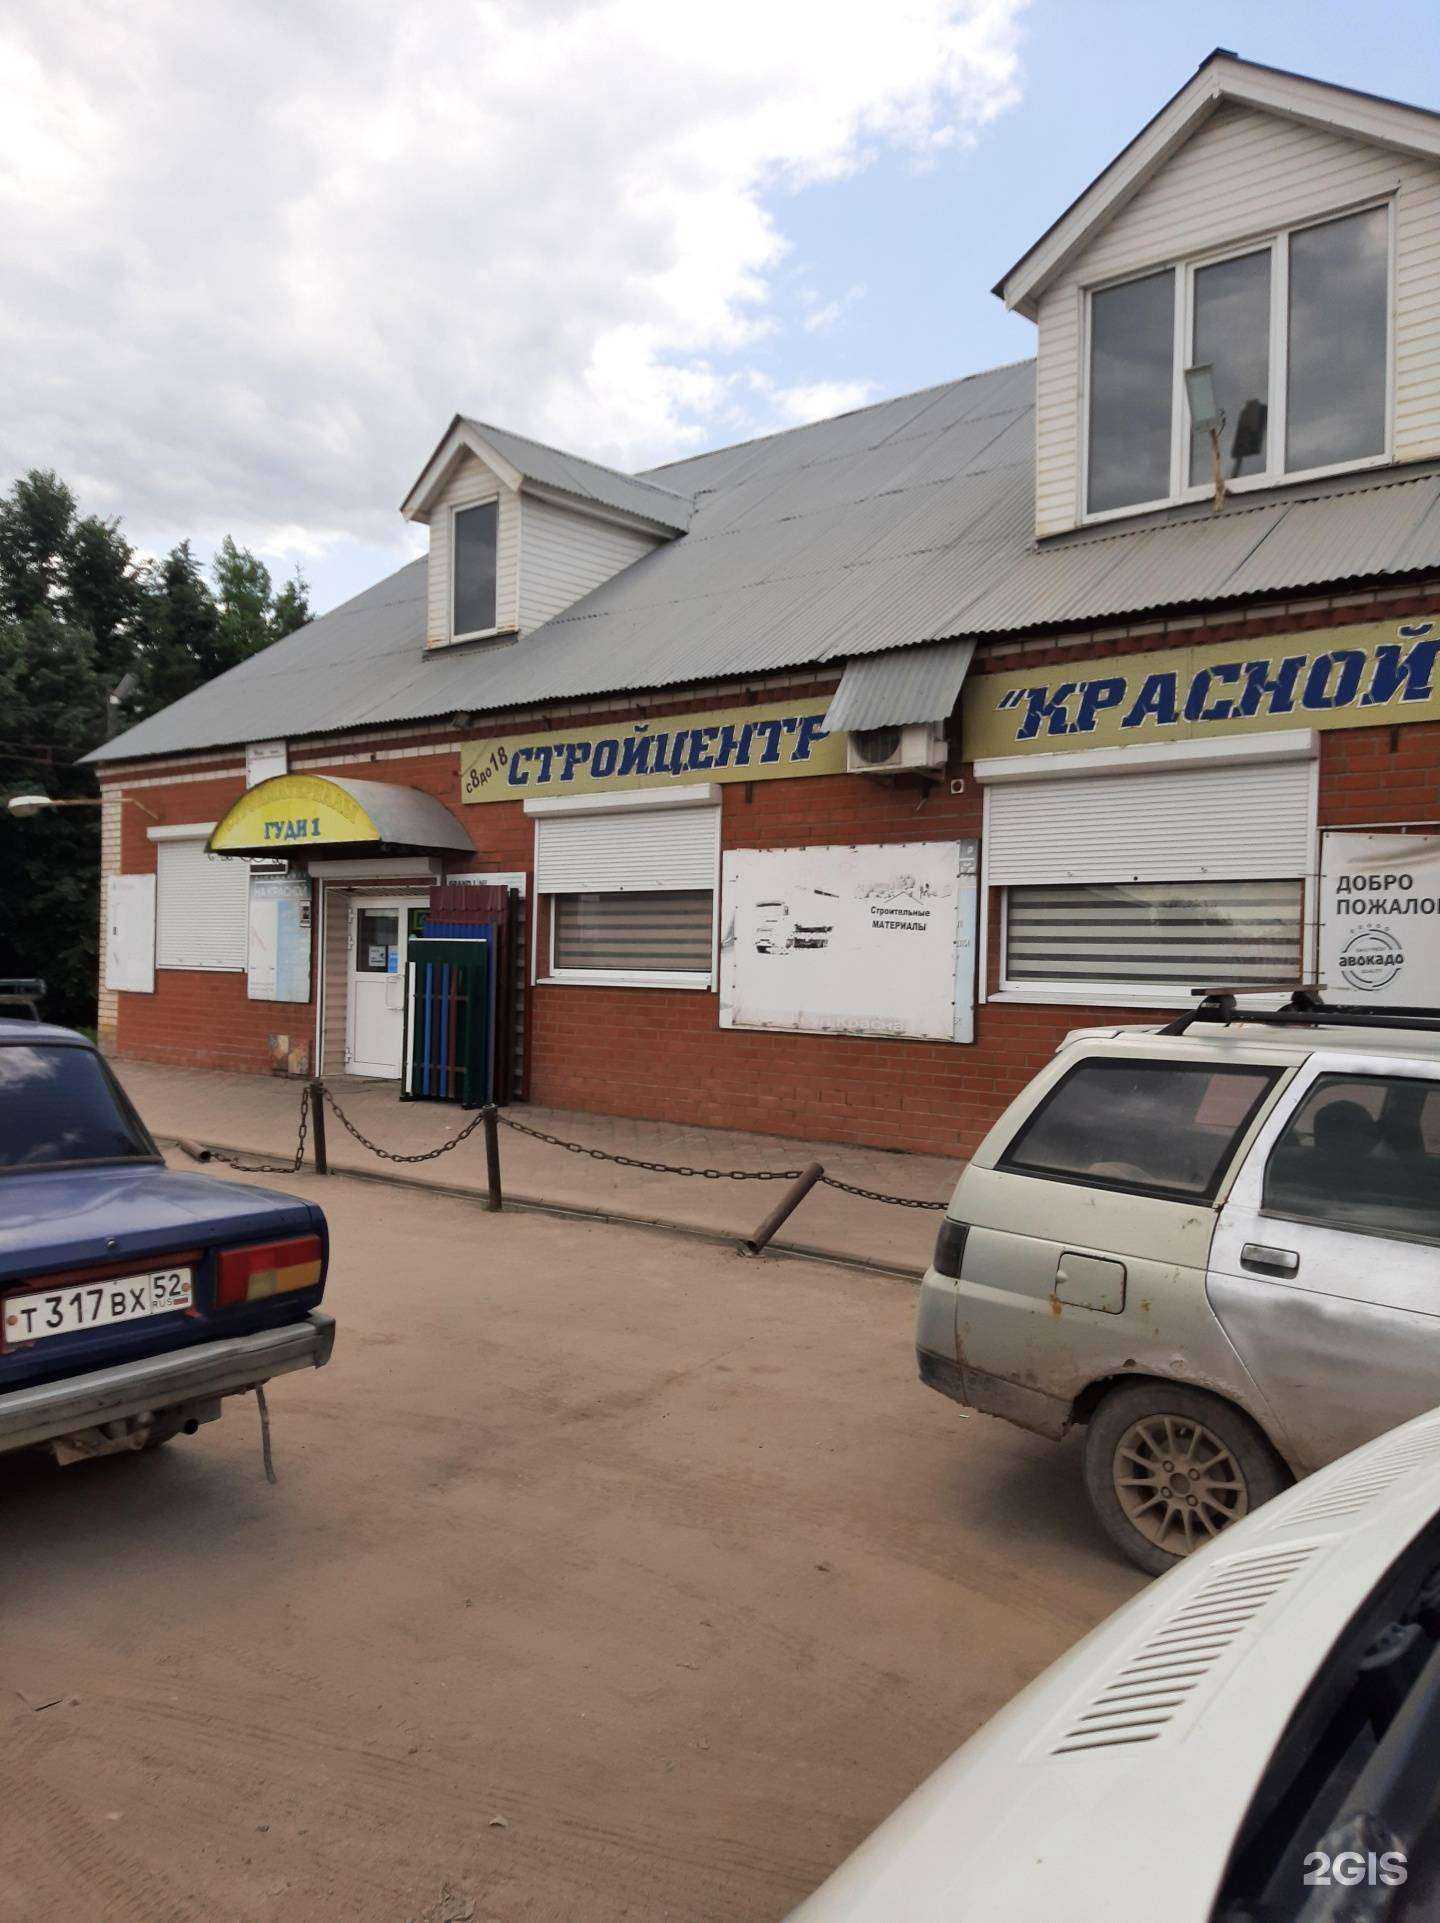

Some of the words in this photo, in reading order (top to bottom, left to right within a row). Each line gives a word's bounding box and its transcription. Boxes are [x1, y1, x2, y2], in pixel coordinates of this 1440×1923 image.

[507, 713, 831, 787] СТРОЙЦЕНТР
[1336, 874, 1413, 894] ДОБРО
[870, 906, 931, 917] Строительные
[1336, 897, 1440, 915] ПОЖАЛО
[872, 920, 927, 931] МАТЕРИАЛЫ
[1339, 954, 1404, 967] авокадо
[152, 1273, 181, 1299] 52
[152, 1298, 173, 1309] RUS
